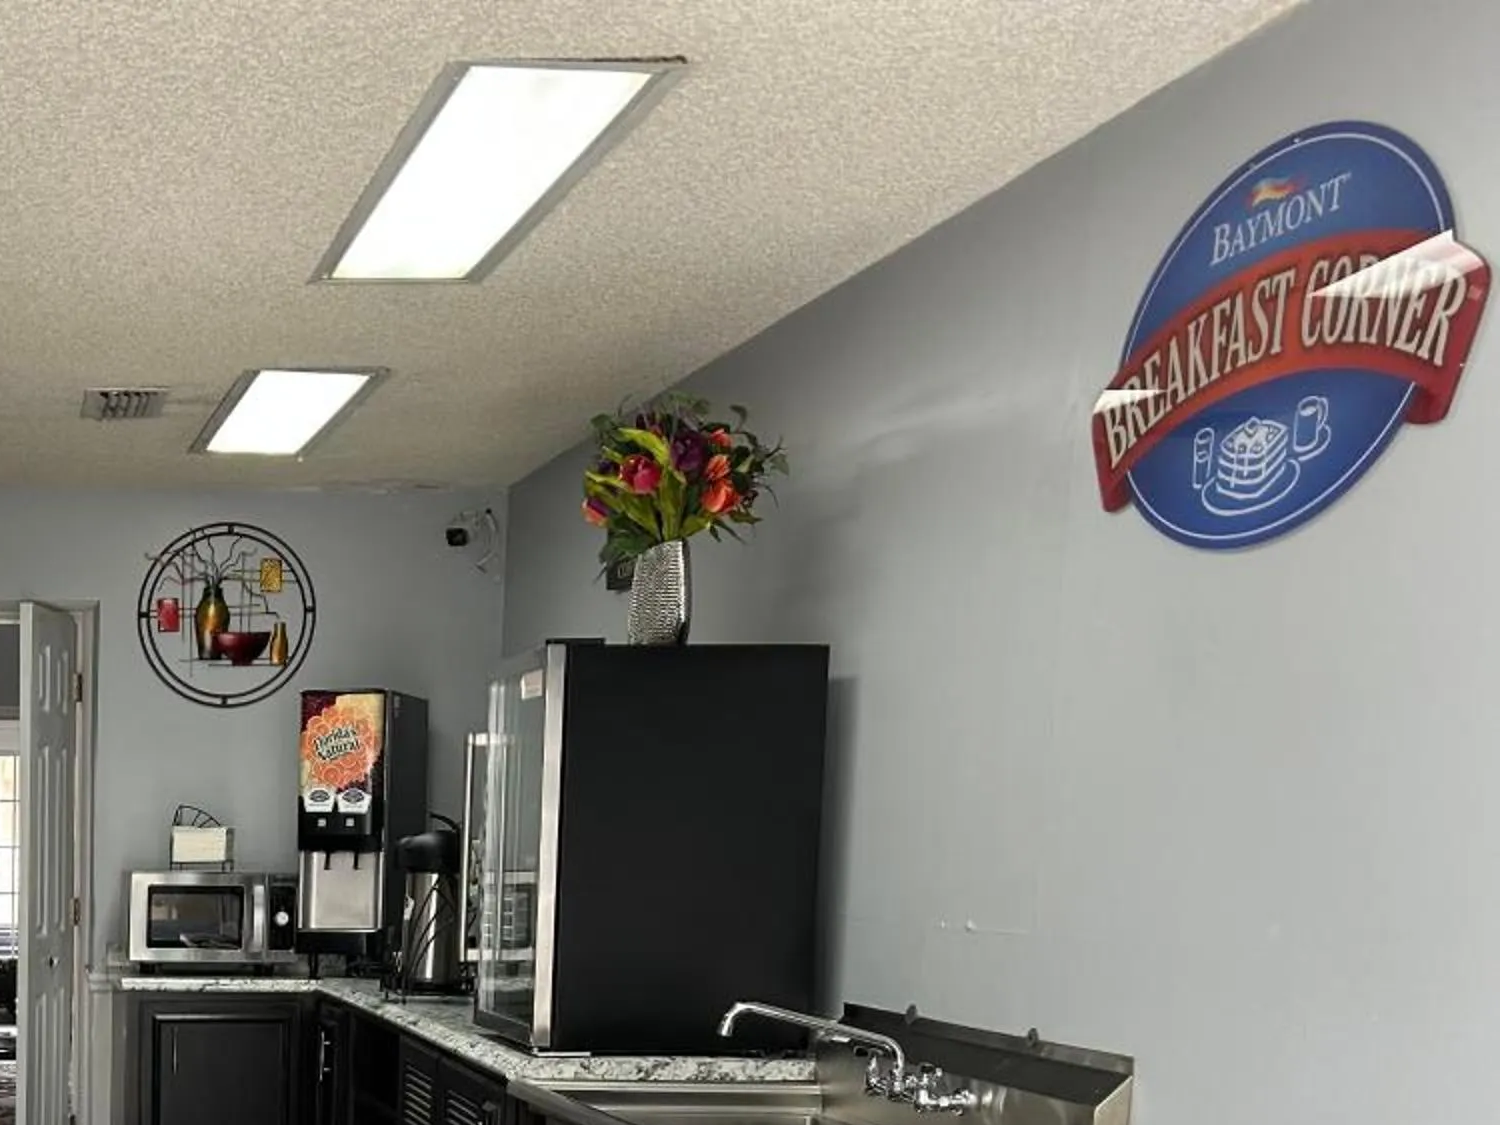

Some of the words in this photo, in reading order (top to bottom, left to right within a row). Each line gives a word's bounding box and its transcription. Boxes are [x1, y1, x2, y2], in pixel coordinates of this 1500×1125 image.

[1211, 172, 1350, 266] BAYMONT
[1102, 267, 1296, 469] BREAKFAST
[1301, 251, 1468, 367] CORNER
